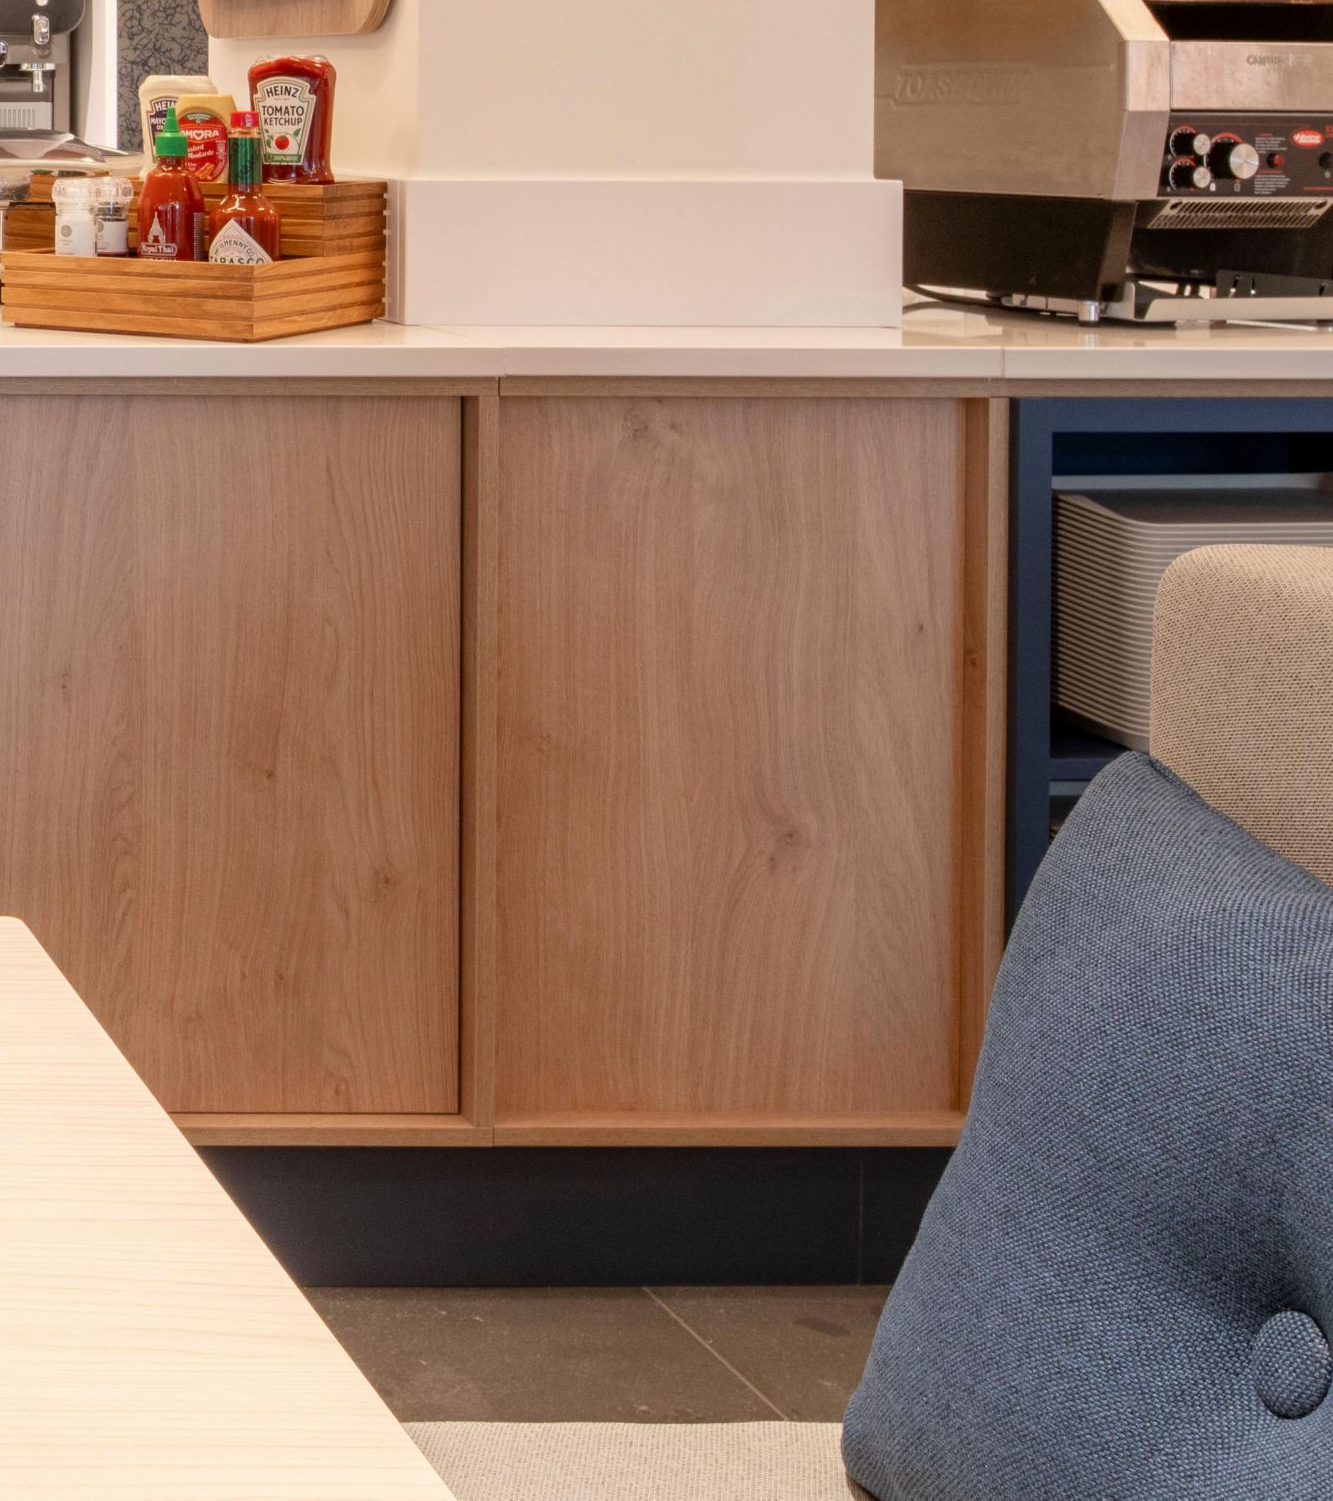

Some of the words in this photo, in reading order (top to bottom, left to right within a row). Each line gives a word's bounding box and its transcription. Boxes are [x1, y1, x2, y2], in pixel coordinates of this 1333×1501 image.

[265, 85, 300, 98] HEINZ
[261, 105, 305, 116] TOMATO
[263, 116, 303, 126] KETCHUP
